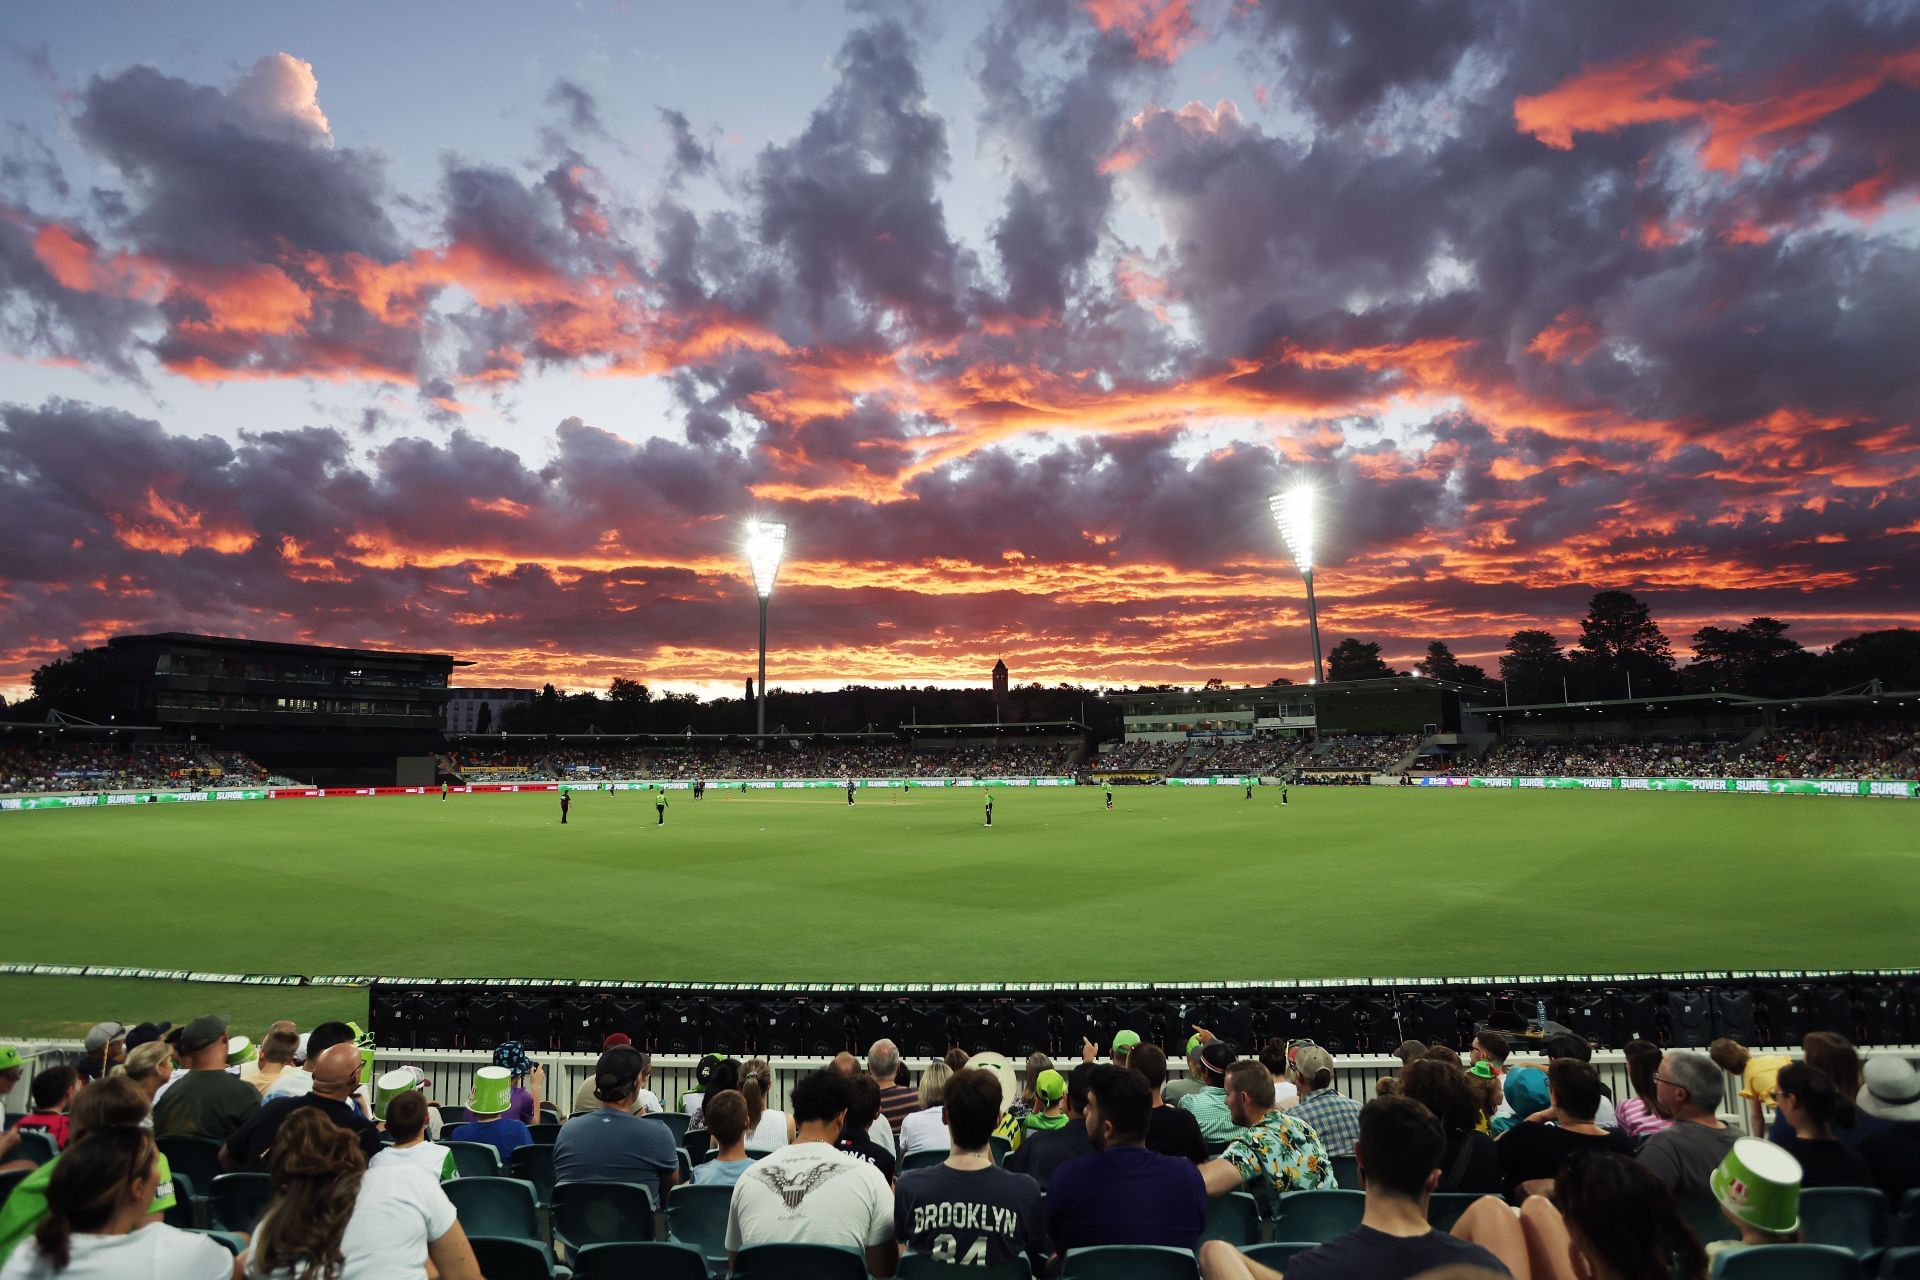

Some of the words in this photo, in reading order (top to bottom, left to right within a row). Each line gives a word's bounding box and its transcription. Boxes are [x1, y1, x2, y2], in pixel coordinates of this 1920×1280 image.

[1485, 779, 1511, 787] POWER
[1519, 779, 1544, 787] SURGE
[1583, 779, 1612, 788] POWER
[1621, 779, 1648, 789] SURGE
[1693, 780, 1726, 790] POWER
[1736, 780, 1768, 791] SURGE
[1820, 781, 1858, 793] POWER
[1870, 782, 1907, 795] SURGE
[65, 796, 98, 806] POWER
[106, 795, 136, 805] SURGE
[177, 792, 208, 801] POWER
[216, 791, 243, 801] SURGE
[914, 1201, 1017, 1238] BROOKLYN
